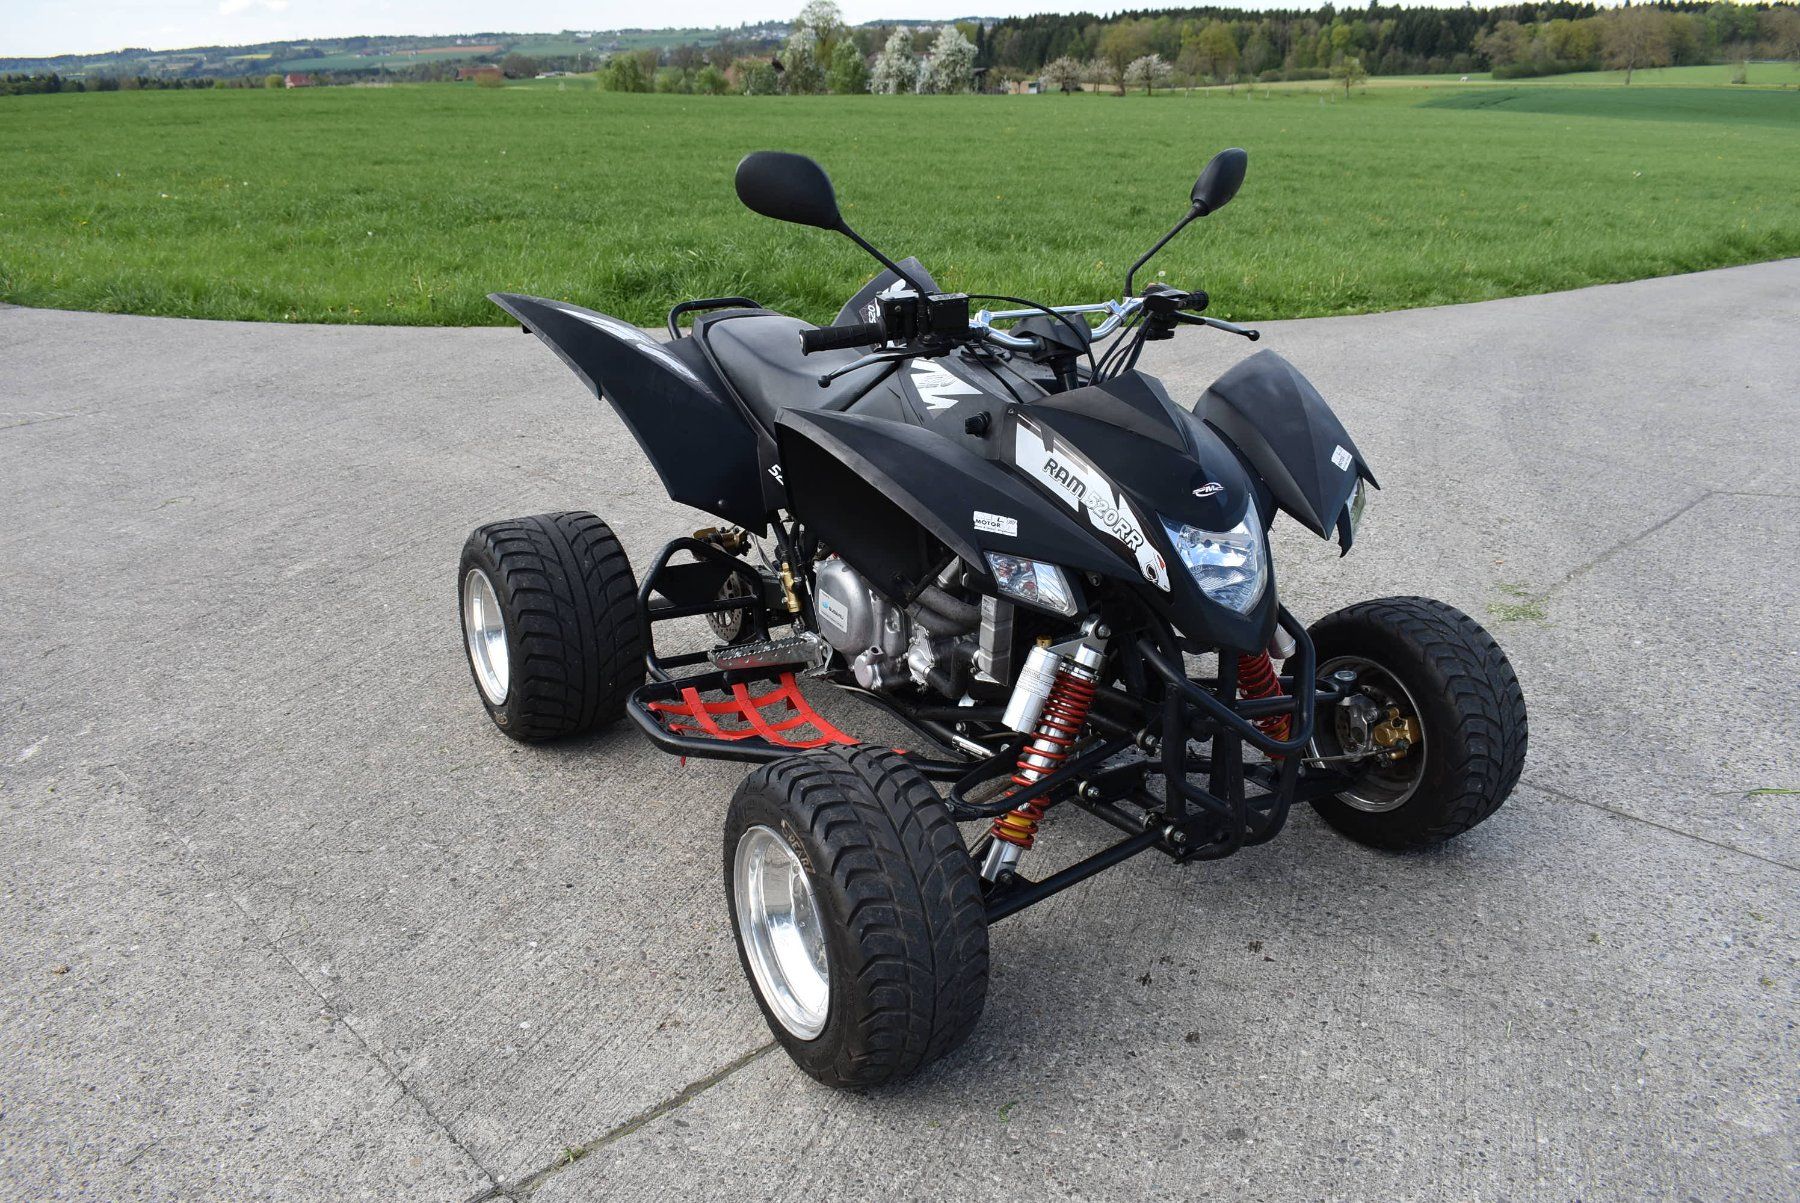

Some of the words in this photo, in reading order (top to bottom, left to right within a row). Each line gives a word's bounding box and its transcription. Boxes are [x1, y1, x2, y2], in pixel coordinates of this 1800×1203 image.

[975, 518, 1001, 528] MOTOR
[1042, 457, 1088, 501] RAM
[1085, 490, 1144, 554] 520RR
